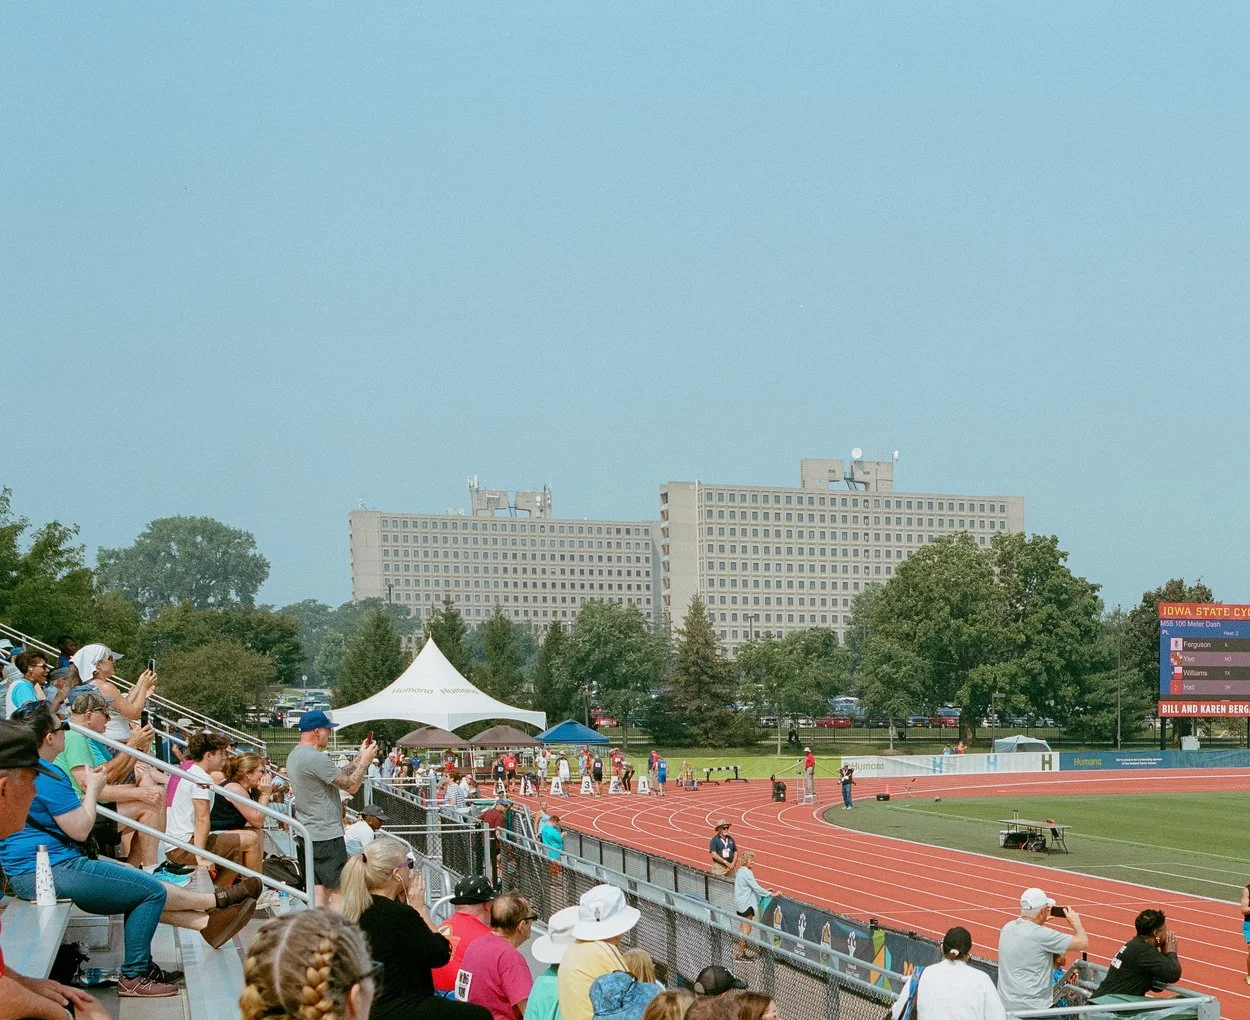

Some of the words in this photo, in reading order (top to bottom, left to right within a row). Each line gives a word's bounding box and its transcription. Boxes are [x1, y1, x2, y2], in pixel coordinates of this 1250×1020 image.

[1163, 606, 1192, 616] IOWA
[1196, 607, 1230, 616] STATE
[1184, 640, 1212, 650] Ferguson
[392, 687, 434, 695] Humana
[1162, 704, 1180, 714] BILL
[1182, 704, 1198, 714] AND
[1200, 704, 1226, 714] KAREN
[1042, 754, 1052, 770] H
[554, 782, 560, 790] 4
[584, 781, 590, 789] 3
[642, 781, 646, 789] 1
